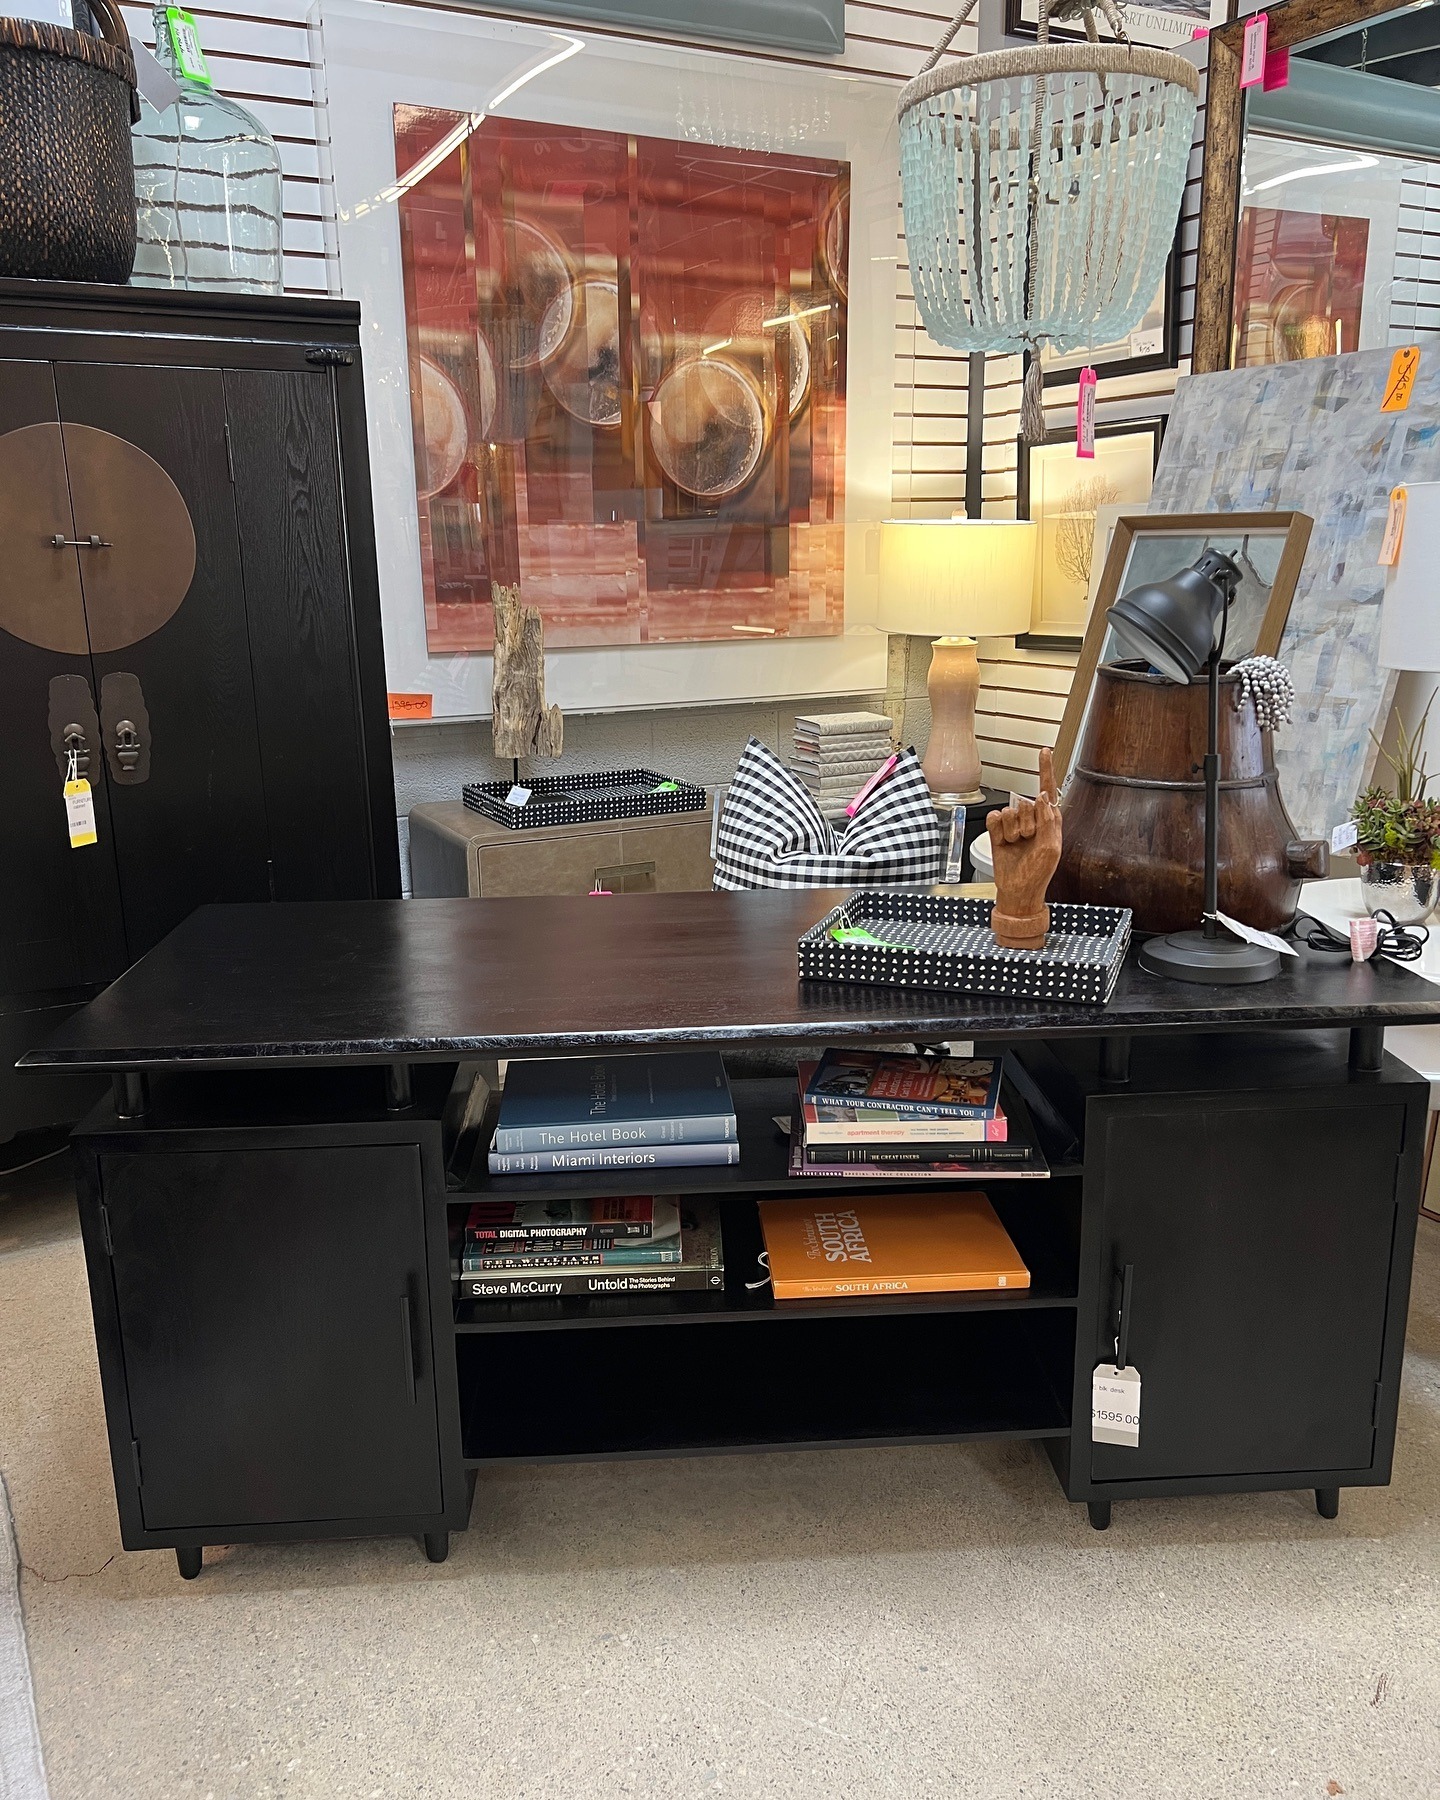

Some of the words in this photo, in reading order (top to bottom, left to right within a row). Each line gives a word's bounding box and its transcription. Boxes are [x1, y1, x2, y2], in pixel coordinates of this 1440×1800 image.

[590, 1100, 606, 1115] The
[822, 1097, 843, 1106] WHAT
[846, 1099, 865, 1108] YOUR
[867, 1101, 914, 1112] CONTRACTOR
[917, 1105, 938, 1114] CAN'T
[941, 1107, 958, 1115] TELL
[959, 1109, 975, 1117] YOU
[539, 1132, 565, 1144] The
[570, 1129, 606, 1143] Hotel
[612, 1127, 647, 1140] Book
[552, 1154, 595, 1167] Miami
[599, 1151, 656, 1166] Interiors
[474, 1231, 498, 1239] TOTAL
[499, 1229, 529, 1238] DIGITAL
[530, 1227, 587, 1237] PHOTOGRAPHY
[813, 1213, 848, 1262] SOUTH
[836, 1209, 872, 1263] AFRICA
[520, 1255, 600, 1264] WILLIAMS
[472, 1284, 507, 1295] Steve
[510, 1281, 562, 1294] McCurry
[588, 1278, 628, 1291] Untold
[835, 1283, 869, 1292] SOUTH
[872, 1282, 908, 1290] AFRICA
